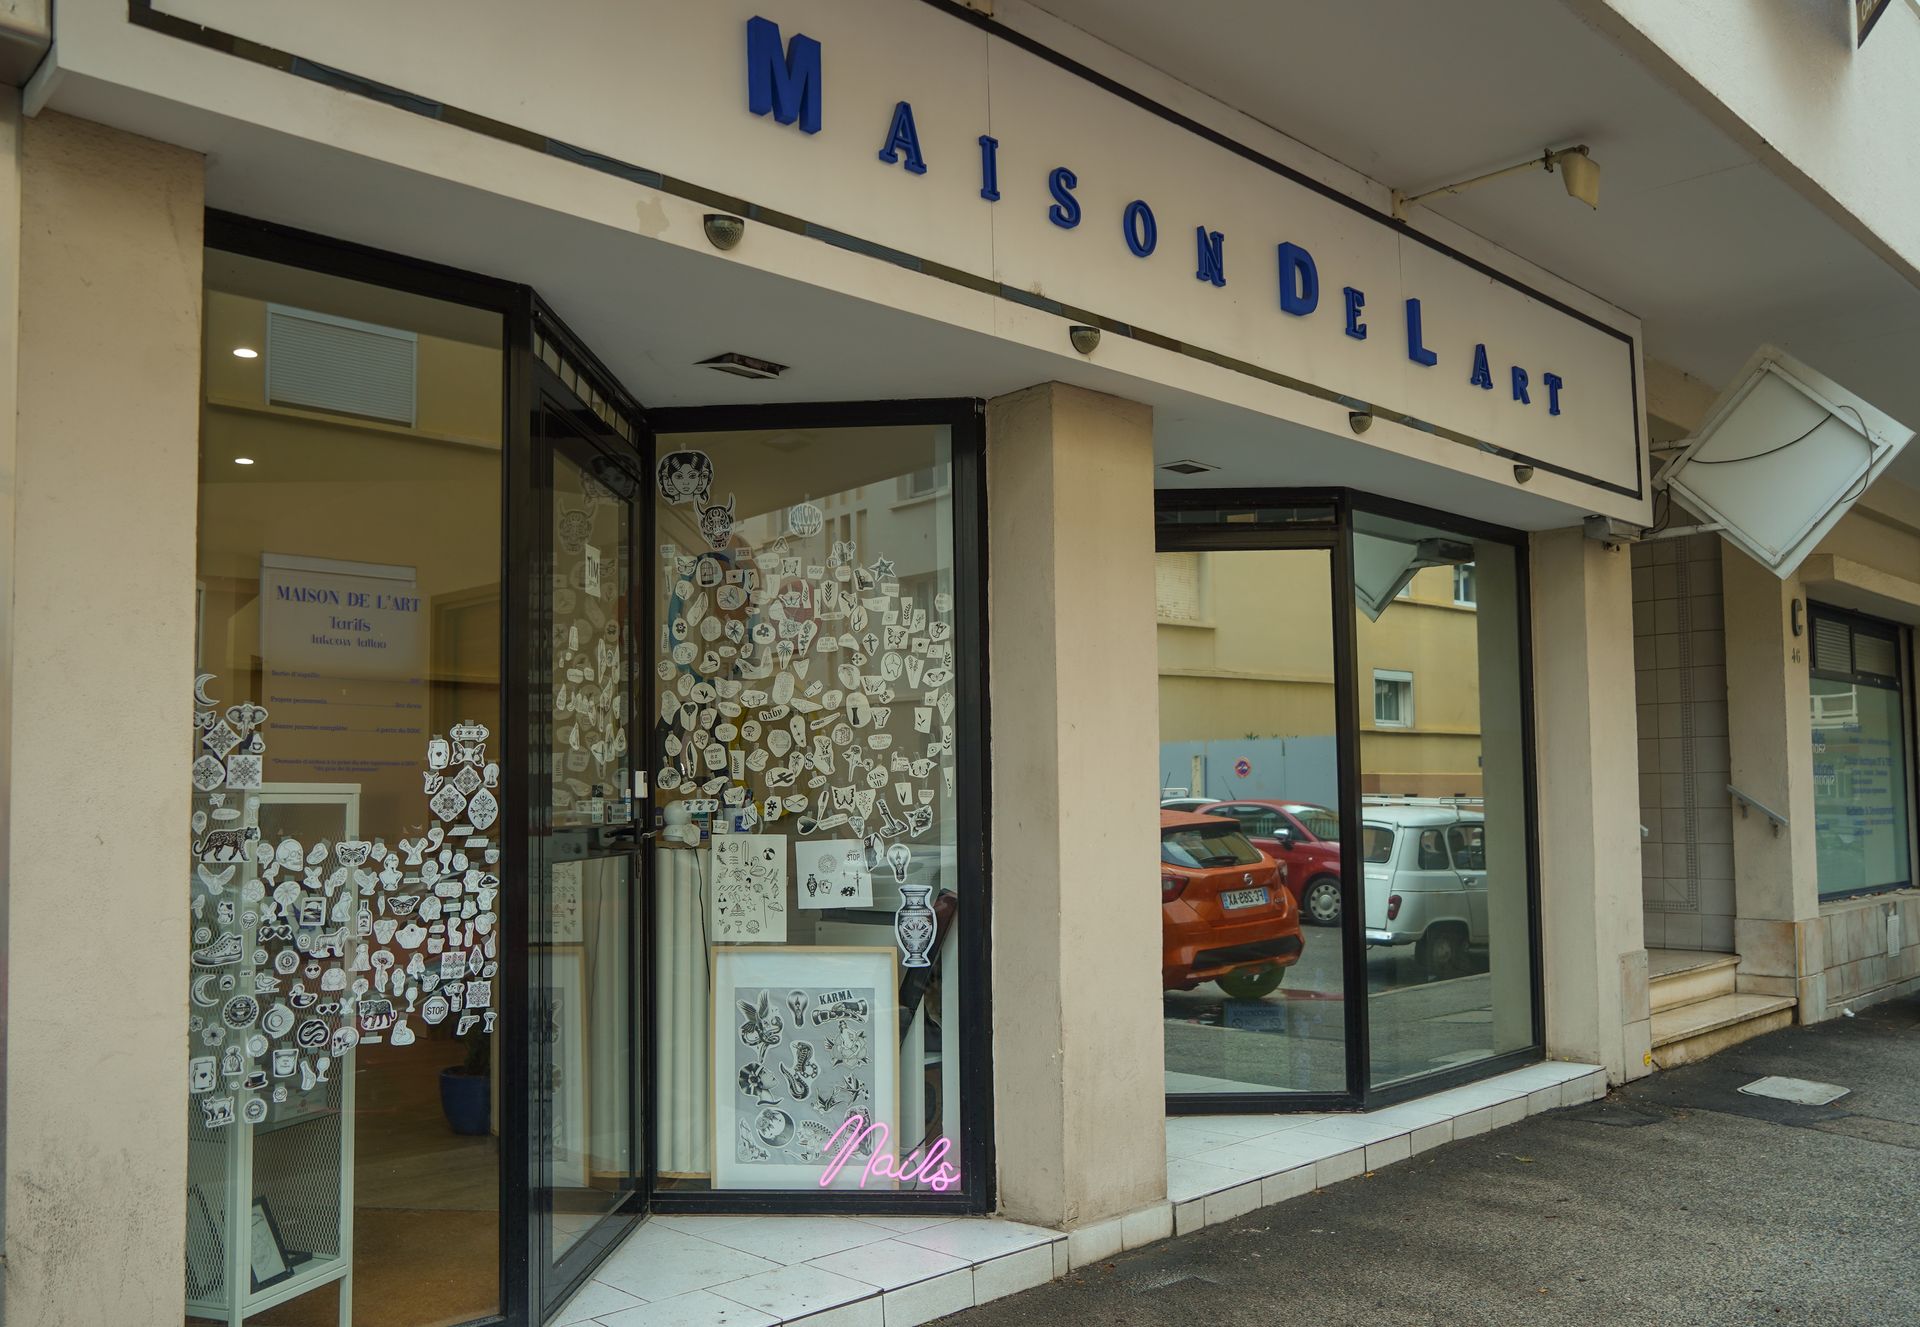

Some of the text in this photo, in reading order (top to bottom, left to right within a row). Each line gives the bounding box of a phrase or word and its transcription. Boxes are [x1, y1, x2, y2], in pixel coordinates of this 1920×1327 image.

[747, 15, 1226, 287] MAISON
[277, 585, 421, 612] MAISON DE L'ART
[329, 616, 371, 632] Tarifs
[1792, 647, 1801, 664] 46
[868, 772, 885, 781] KISS
[873, 779, 884, 787] ME
[847, 853, 861, 861] STOP
[819, 990, 853, 1005] KARMA
[426, 1007, 445, 1016] STOP
[820, 1114, 960, 1191] Nails
